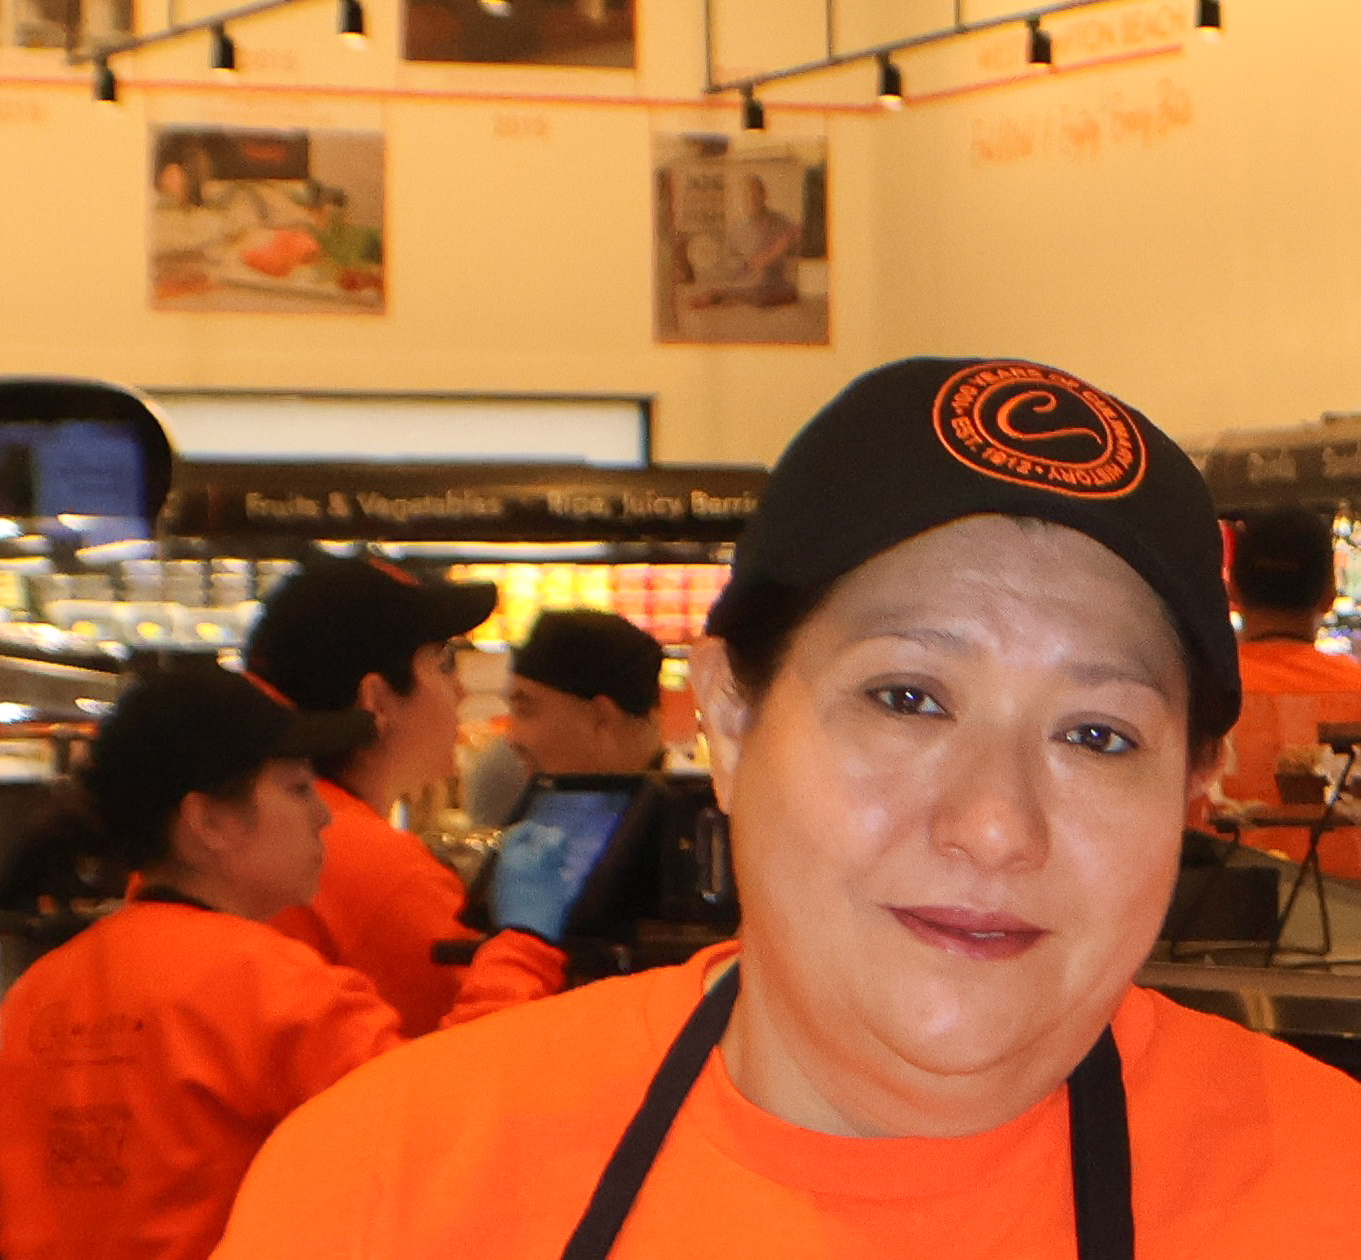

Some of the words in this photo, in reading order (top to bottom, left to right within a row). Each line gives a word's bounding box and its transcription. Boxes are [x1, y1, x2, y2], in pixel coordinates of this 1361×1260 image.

[244, 490, 320, 518] Fruits
[326, 490, 350, 518] &
[355, 489, 503, 523] Vegetables
[620, 488, 687, 522] Juicy
